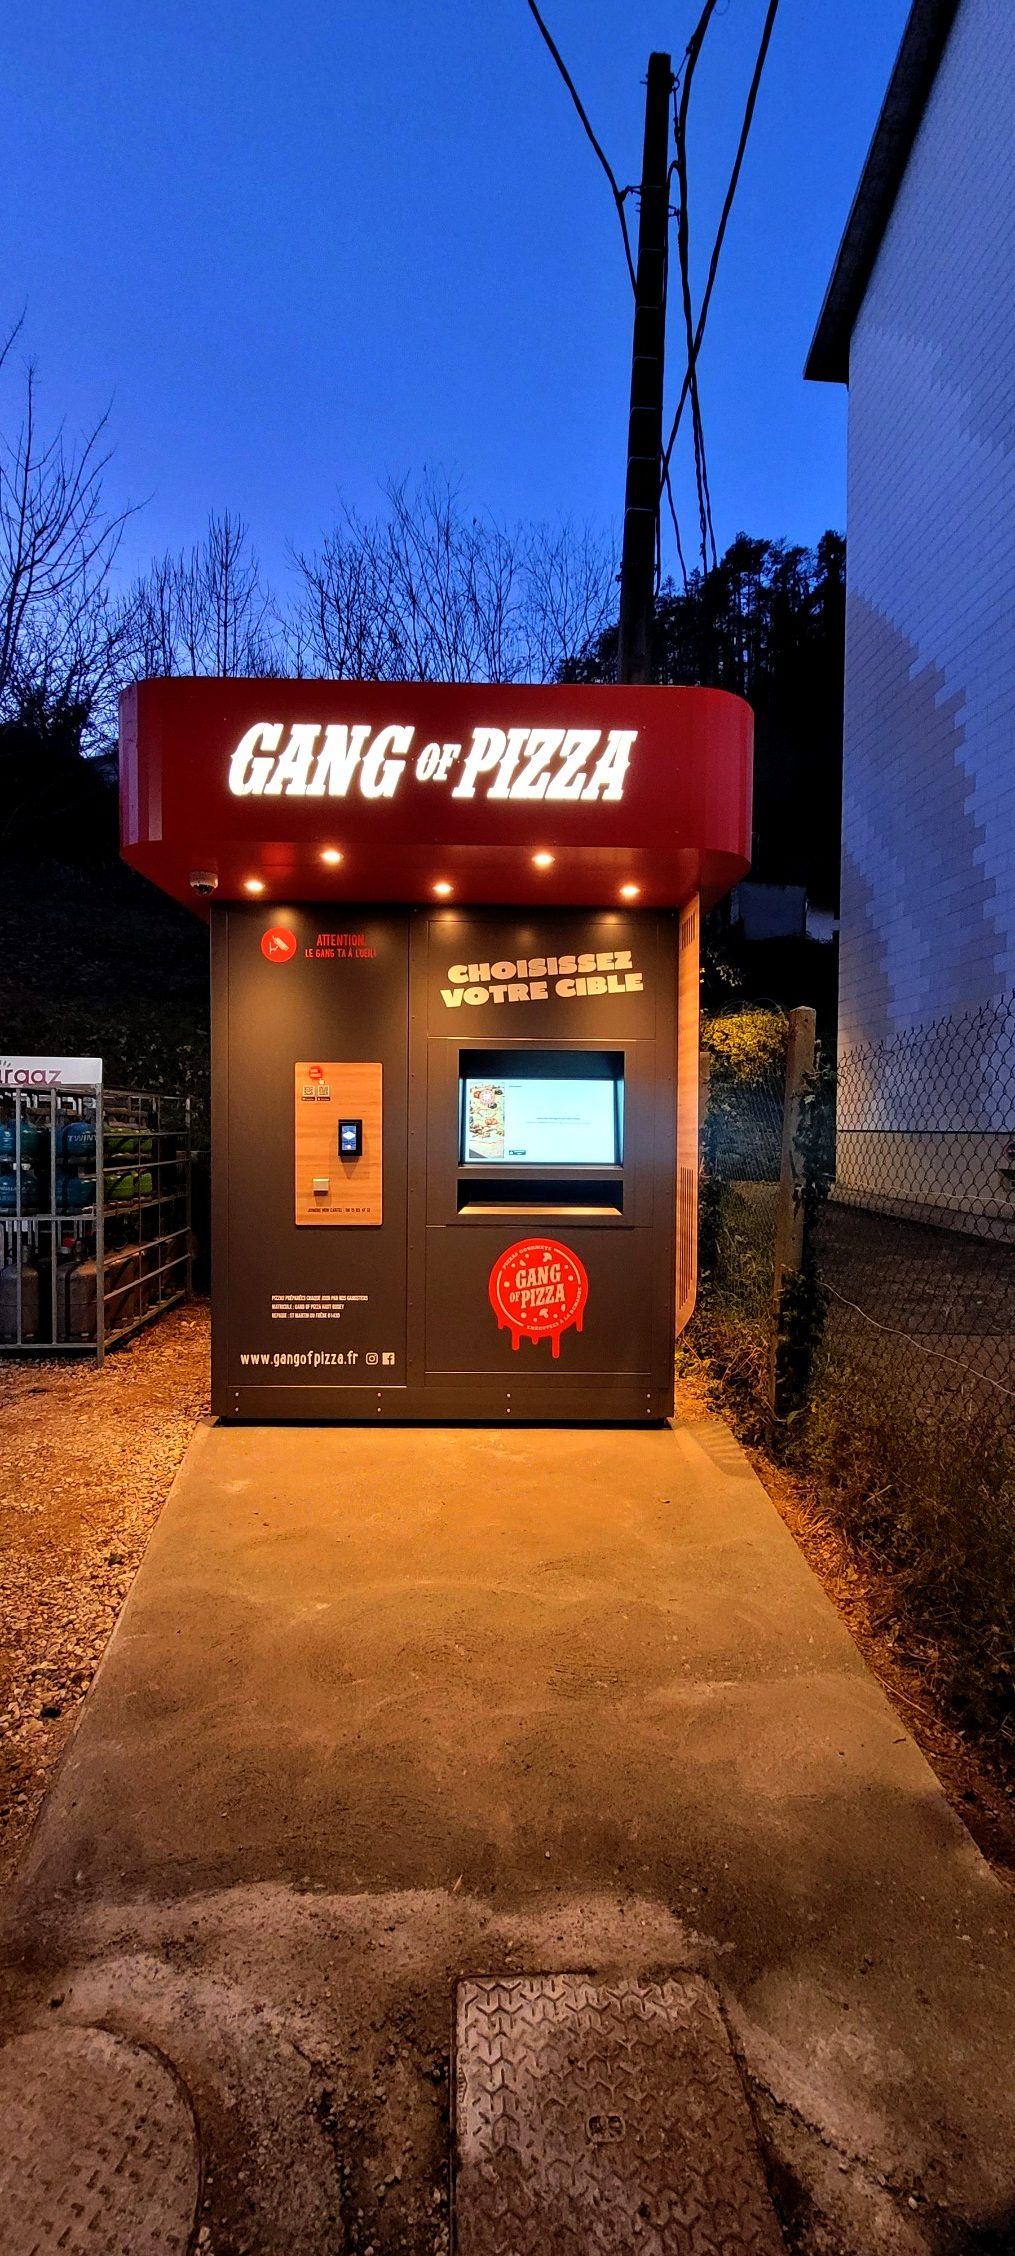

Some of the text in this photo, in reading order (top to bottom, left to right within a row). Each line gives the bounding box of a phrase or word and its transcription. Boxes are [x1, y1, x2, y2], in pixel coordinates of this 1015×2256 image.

[228, 722, 638, 800] GANG OF PIZZA
[305, 948, 314, 958] LE
[447, 951, 632, 984] CHOISISSEZ
[440, 973, 644, 1008] VOTRE CIBLE
[515, 1263, 561, 1289] GANG
[509, 1283, 566, 1309] OF PIZZA
[240, 1350, 359, 1368] www.gangofpizza.fr
